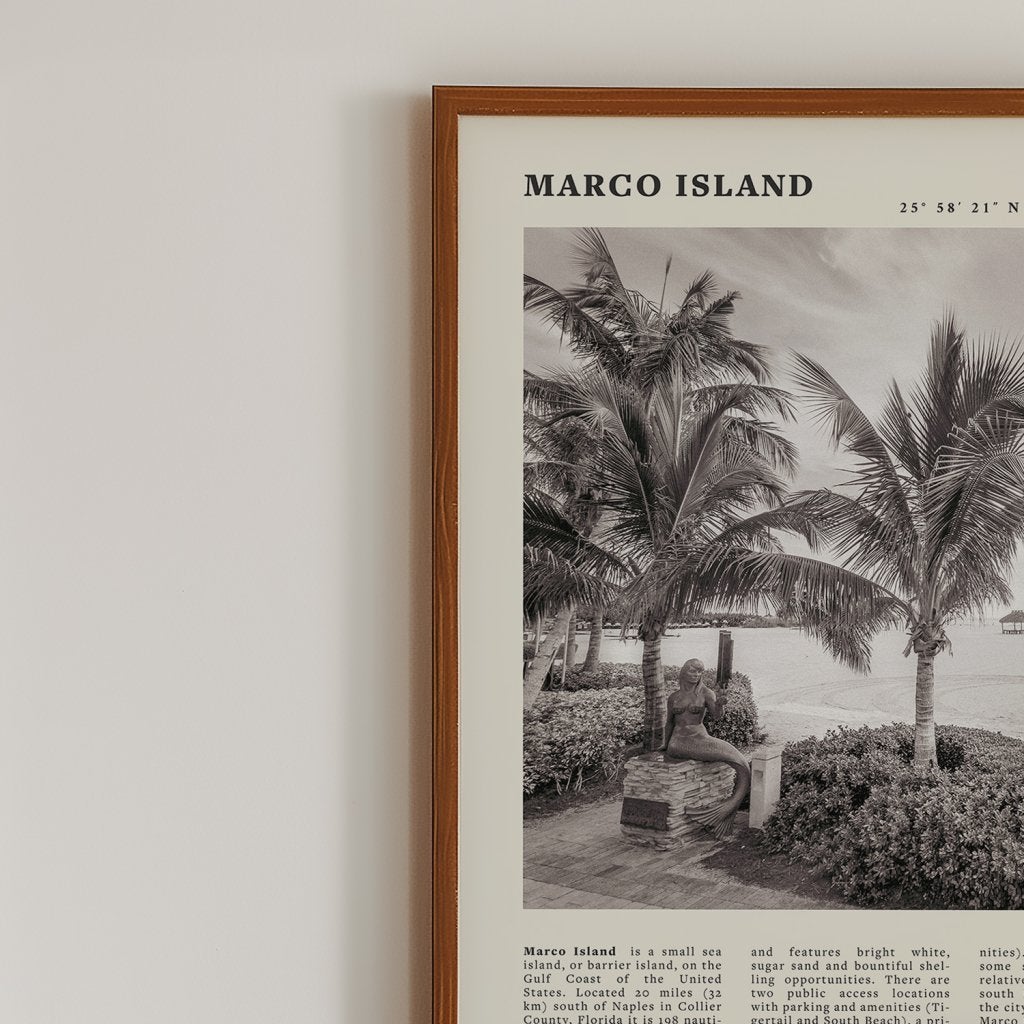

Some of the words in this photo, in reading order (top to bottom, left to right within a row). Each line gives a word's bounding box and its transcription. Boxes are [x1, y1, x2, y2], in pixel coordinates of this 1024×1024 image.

[524, 174, 661, 197] MARCO
[676, 174, 812, 197] ISLAND
[900, 202, 926, 213] 25°
[1008, 202, 1018, 213] N
[523, 946, 566, 956] Marco
[573, 946, 616, 956] Island
[630, 946, 641, 956] is
[648, 948, 654, 956] a
[661, 946, 695, 956] small
[702, 948, 722, 956] sea
[751, 947, 773, 957] and
[789, 947, 841, 957] features
[857, 947, 895, 960] bright
[911, 947, 950, 959] white,
[980, 948, 1024, 961] nities).
[751, 963, 785, 974] sugar
[791, 961, 819, 971] sand
[825, 961, 848, 971] and
[854, 961, 913, 971] bountiful
[919, 961, 950, 971] shel-
[979, 964, 1011, 972] some
[523, 973, 551, 984] Gulf
[565, 973, 601, 984] Coast
[616, 973, 630, 984] of
[644, 973, 664, 984] the
[680, 973, 722, 984] United
[751, 974, 775, 988] ling
[784, 974, 875, 988] opportunities.
[884, 974, 921, 985] There
[930, 977, 950, 985] are
[523, 987, 566, 997] States.
[576, 987, 625, 997] Located
[659, 987, 693, 997] miles
[703, 987, 722, 1000] (32
[751, 989, 774, 998] two
[787, 988, 826, 1001] public
[892, 988, 950, 998] locations
[979, 989, 1014, 999] south
[751, 1002, 778, 1012] with
[783, 1002, 830, 1015] parking
[834, 1002, 856, 1012] and
[860, 1002, 921, 1012] amenities
[925, 1002, 949, 1015] (Ti-
